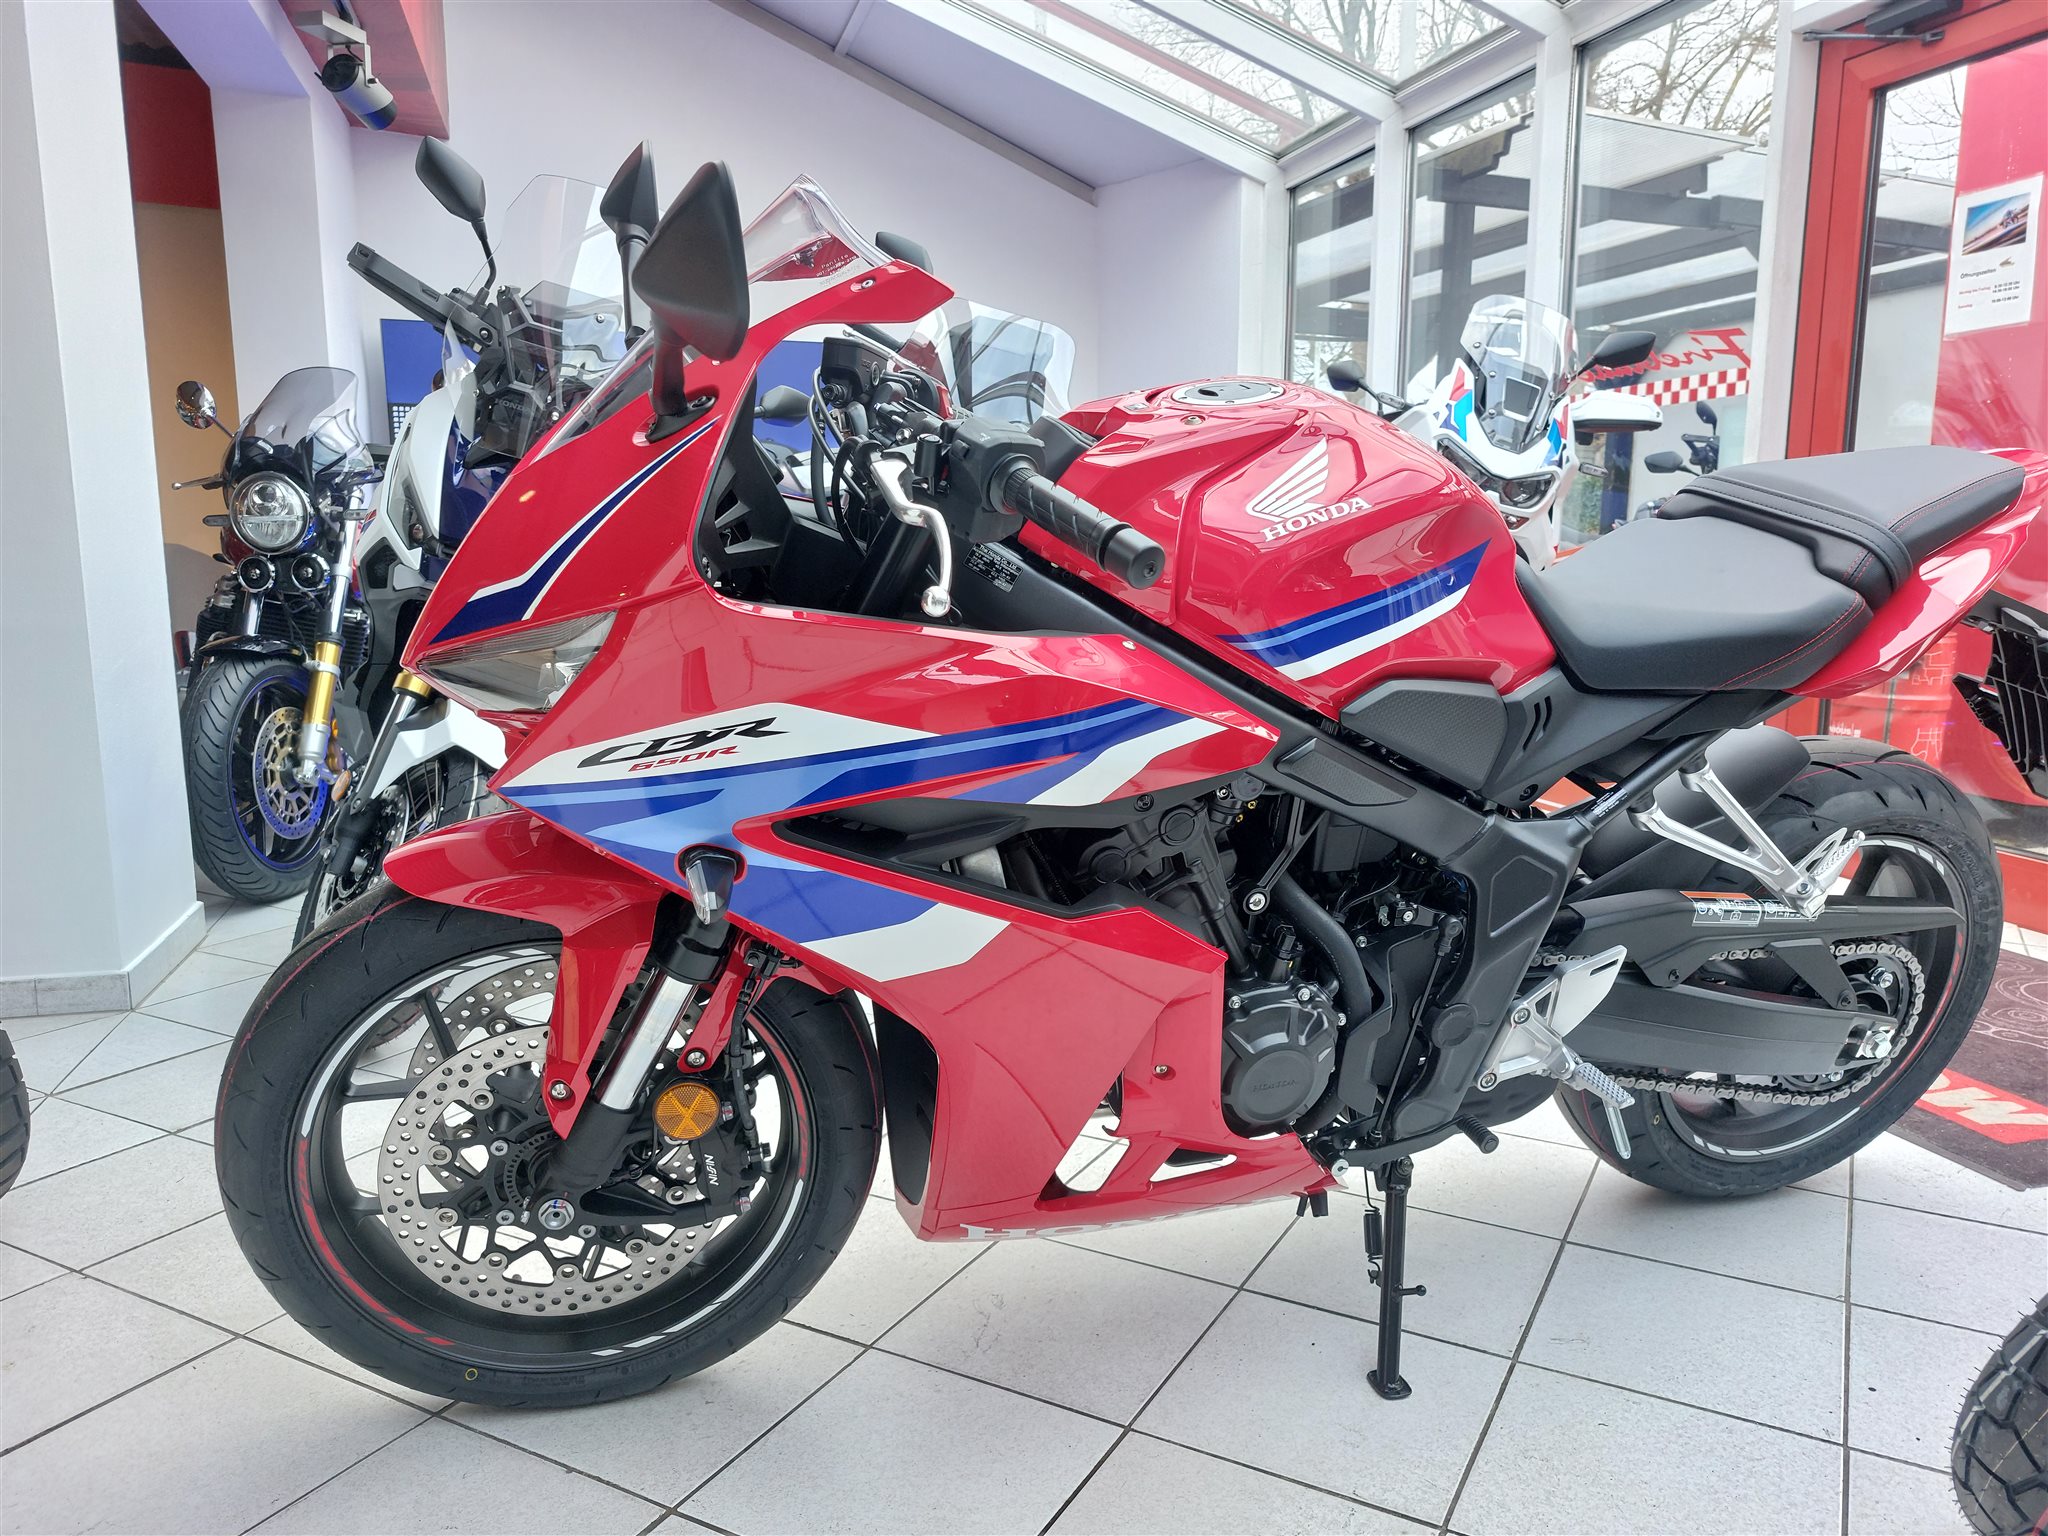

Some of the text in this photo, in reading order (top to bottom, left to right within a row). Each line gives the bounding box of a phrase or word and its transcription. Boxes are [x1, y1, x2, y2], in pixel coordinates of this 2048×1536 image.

[1260, 496, 1372, 542] HONDA
[577, 716, 791, 768] CBR
[628, 745, 740, 772] 650R
